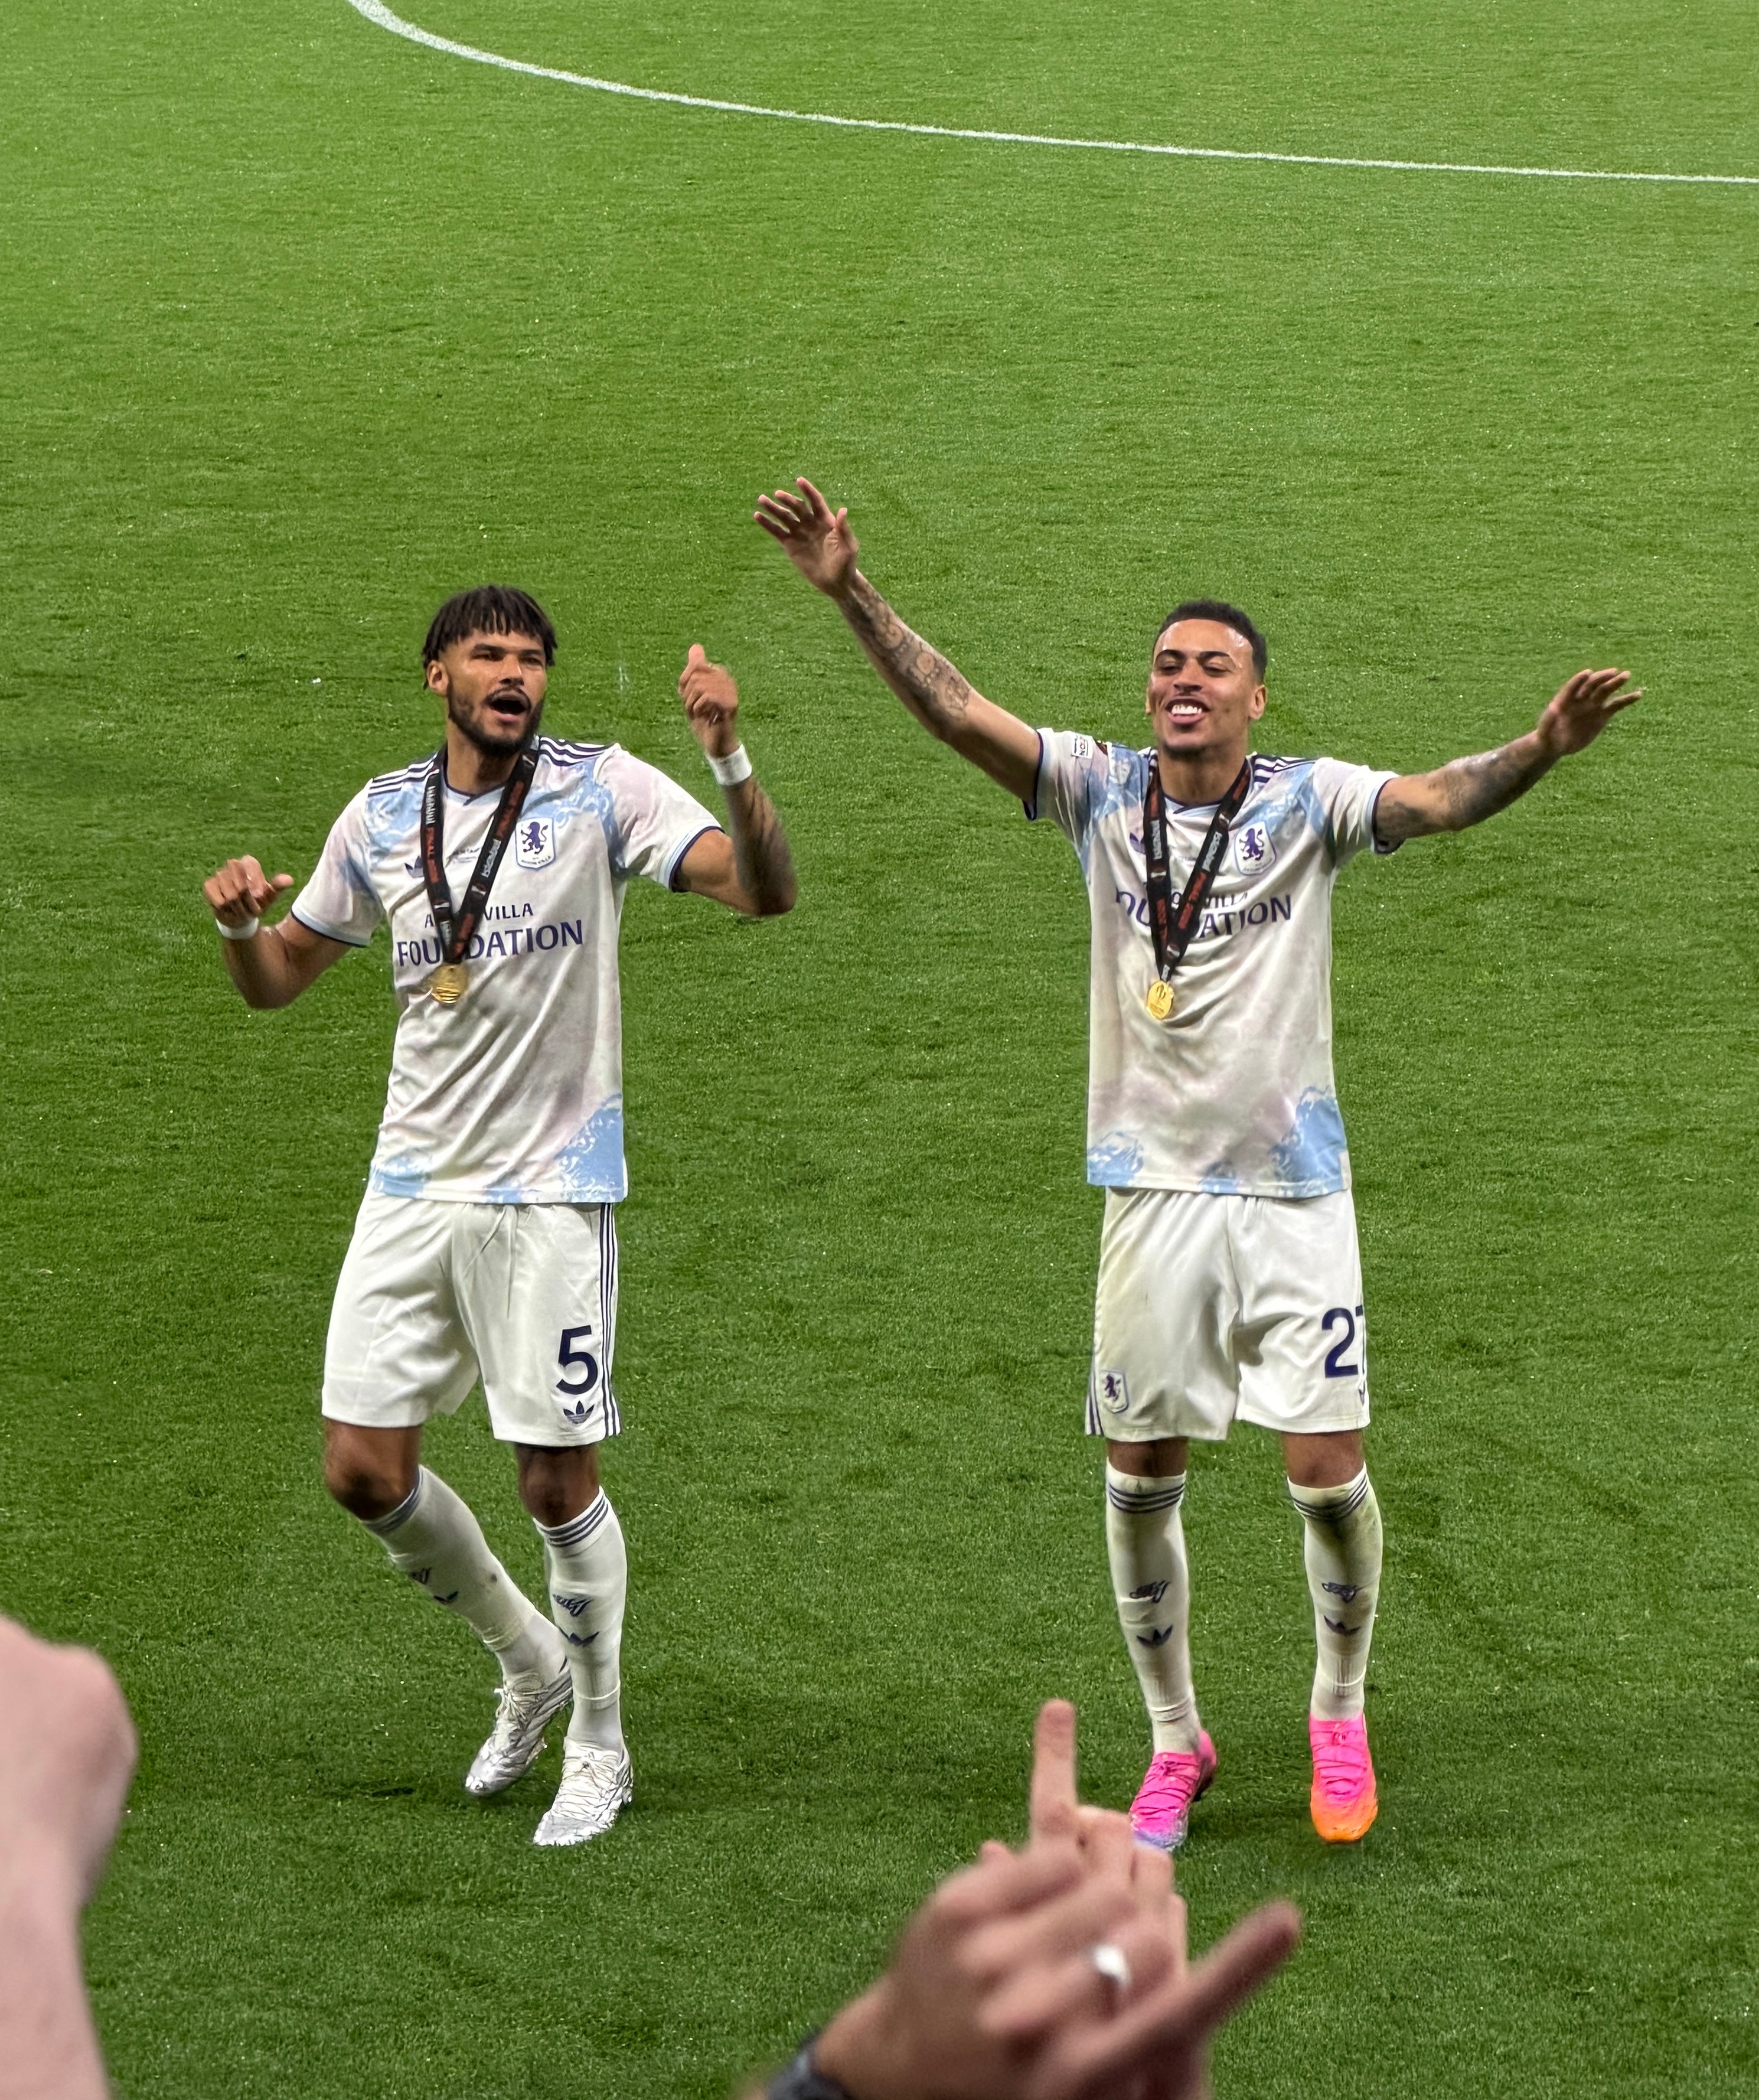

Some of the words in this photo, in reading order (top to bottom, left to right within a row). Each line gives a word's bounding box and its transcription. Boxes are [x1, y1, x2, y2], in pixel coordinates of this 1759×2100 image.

[484, 903, 534, 921] VILLA
[397, 919, 583, 967] FOUDATION
[556, 1325, 598, 1395] 5
[1321, 1305, 1363, 1378] 2
